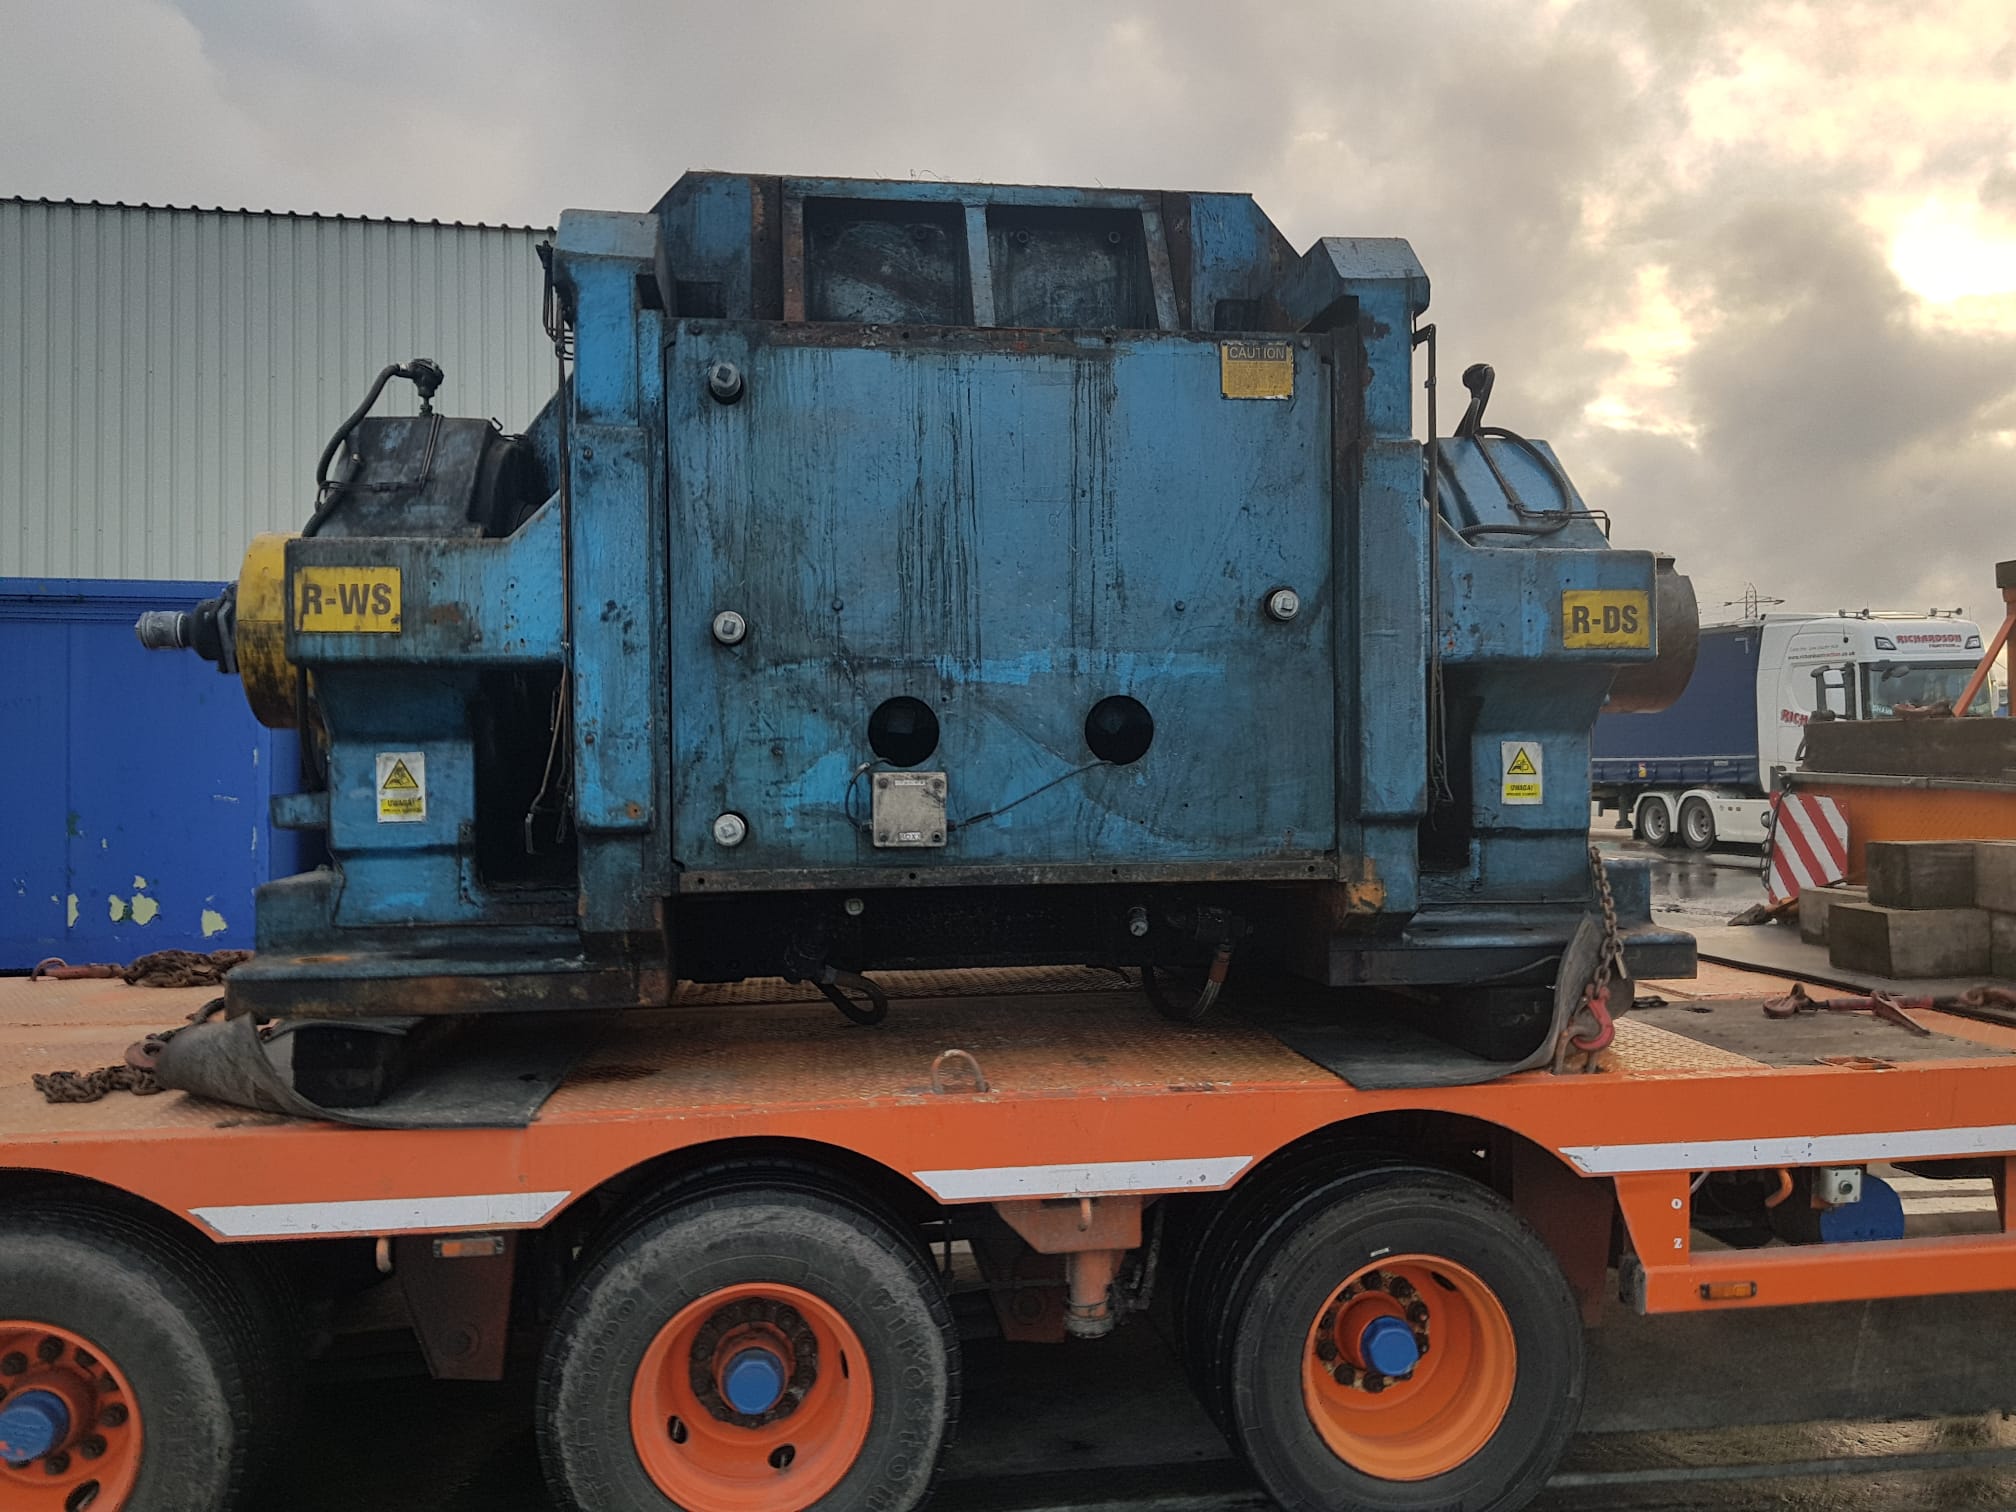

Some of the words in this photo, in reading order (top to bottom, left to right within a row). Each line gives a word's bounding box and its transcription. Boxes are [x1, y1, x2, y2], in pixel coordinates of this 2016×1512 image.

[1229, 346, 1284, 359] CAUTION
[301, 582, 392, 615] R-WS
[1571, 604, 1638, 634] R-DS
[1896, 634, 1962, 643] RICHARDSON
[1780, 708, 1809, 727] RICH
